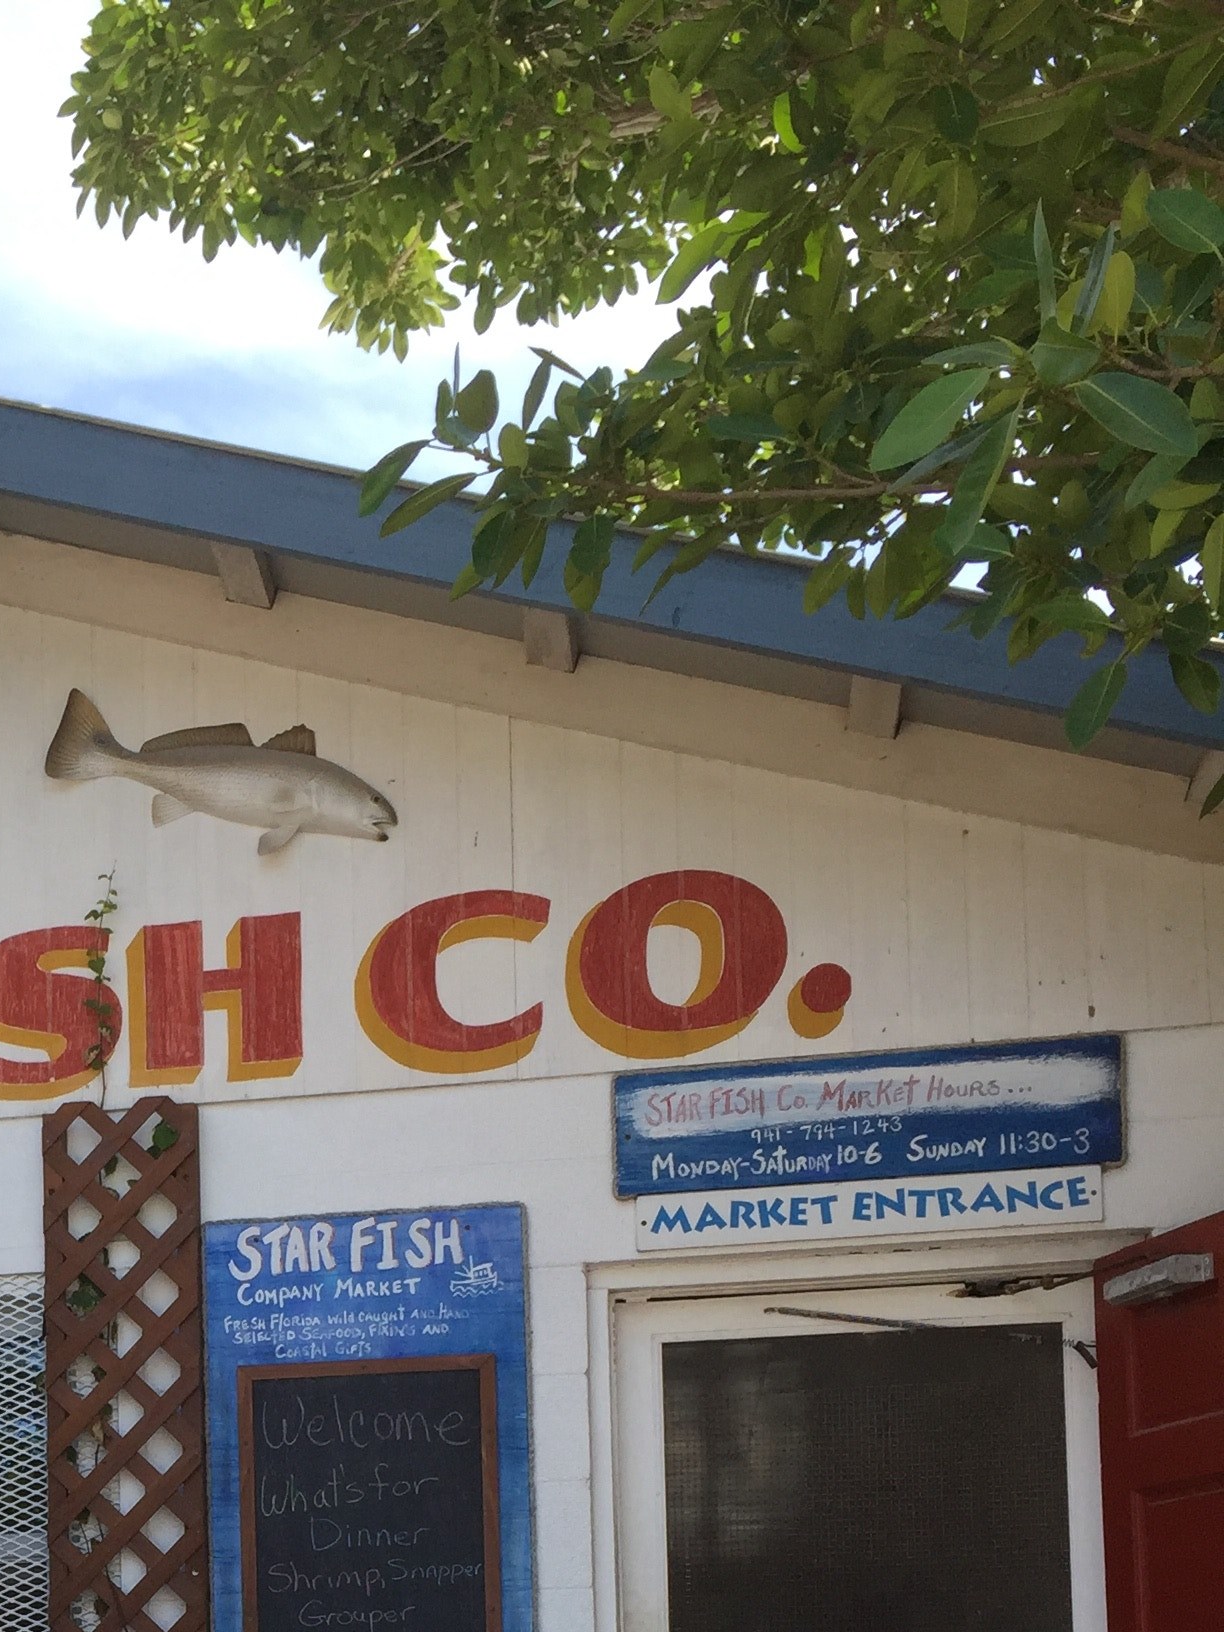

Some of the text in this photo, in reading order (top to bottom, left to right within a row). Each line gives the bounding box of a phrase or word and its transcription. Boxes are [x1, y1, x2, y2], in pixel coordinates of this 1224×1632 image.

[354, 868, 852, 1075] CO.
[645, 1090, 702, 1128] STAR
[708, 1086, 766, 1119] FISH
[751, 1115, 903, 1144] 941-794-1243
[837, 1141, 883, 1167] 10-6
[999, 1127, 1091, 1156] 11:30-3
[649, 1174, 1092, 1236] MARKET ENTRANCE
[228, 1216, 465, 1282] STAR FISH
[262, 1395, 470, 1449] Welcome
[369, 1462, 439, 1501] for
[310, 1516, 429, 1551] Dinner
[298, 1600, 416, 1632] Grouper
